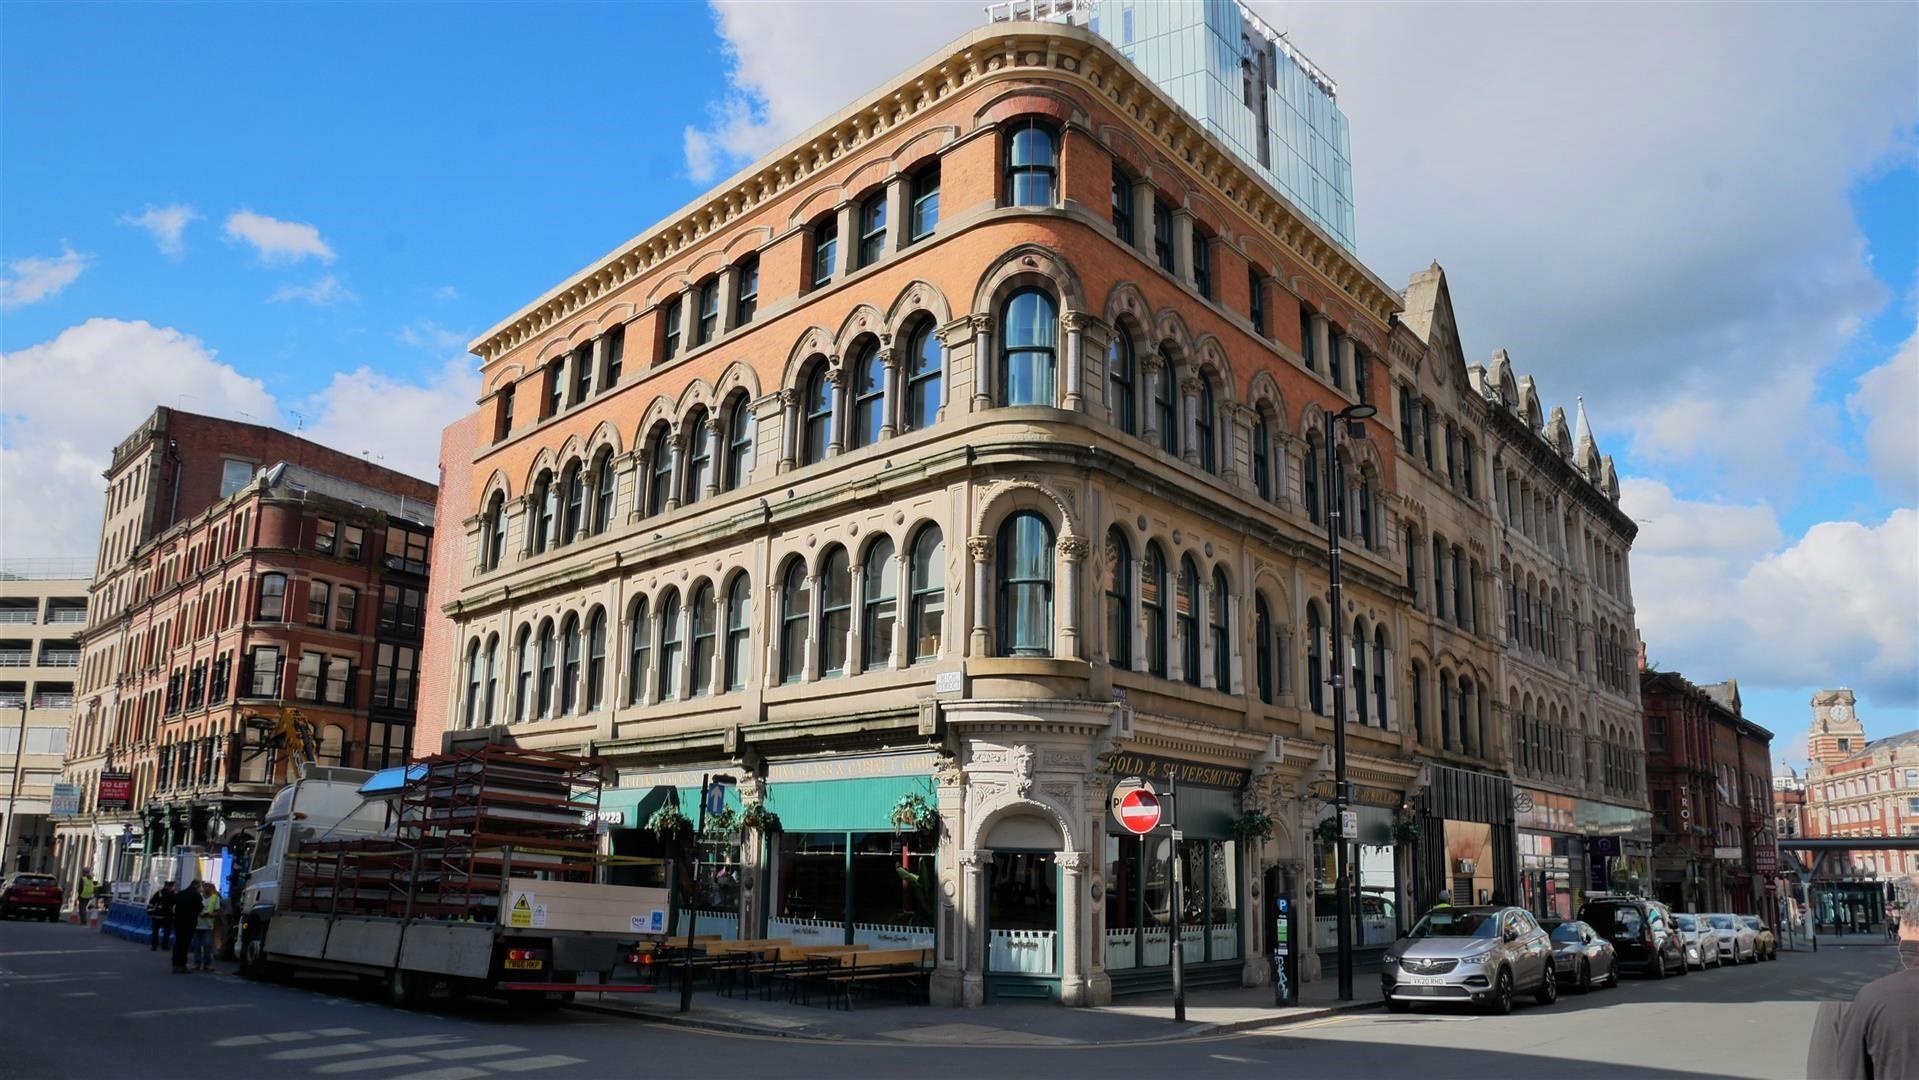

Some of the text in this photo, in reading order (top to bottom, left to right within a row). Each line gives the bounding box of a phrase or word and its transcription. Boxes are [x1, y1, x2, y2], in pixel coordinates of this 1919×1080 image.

[902, 755, 933, 770] GOOD
[1109, 754, 1243, 788] GOLD & SILVERSMITHS
[1680, 786, 1690, 831] TROF
[1280, 900, 1287, 911] P
